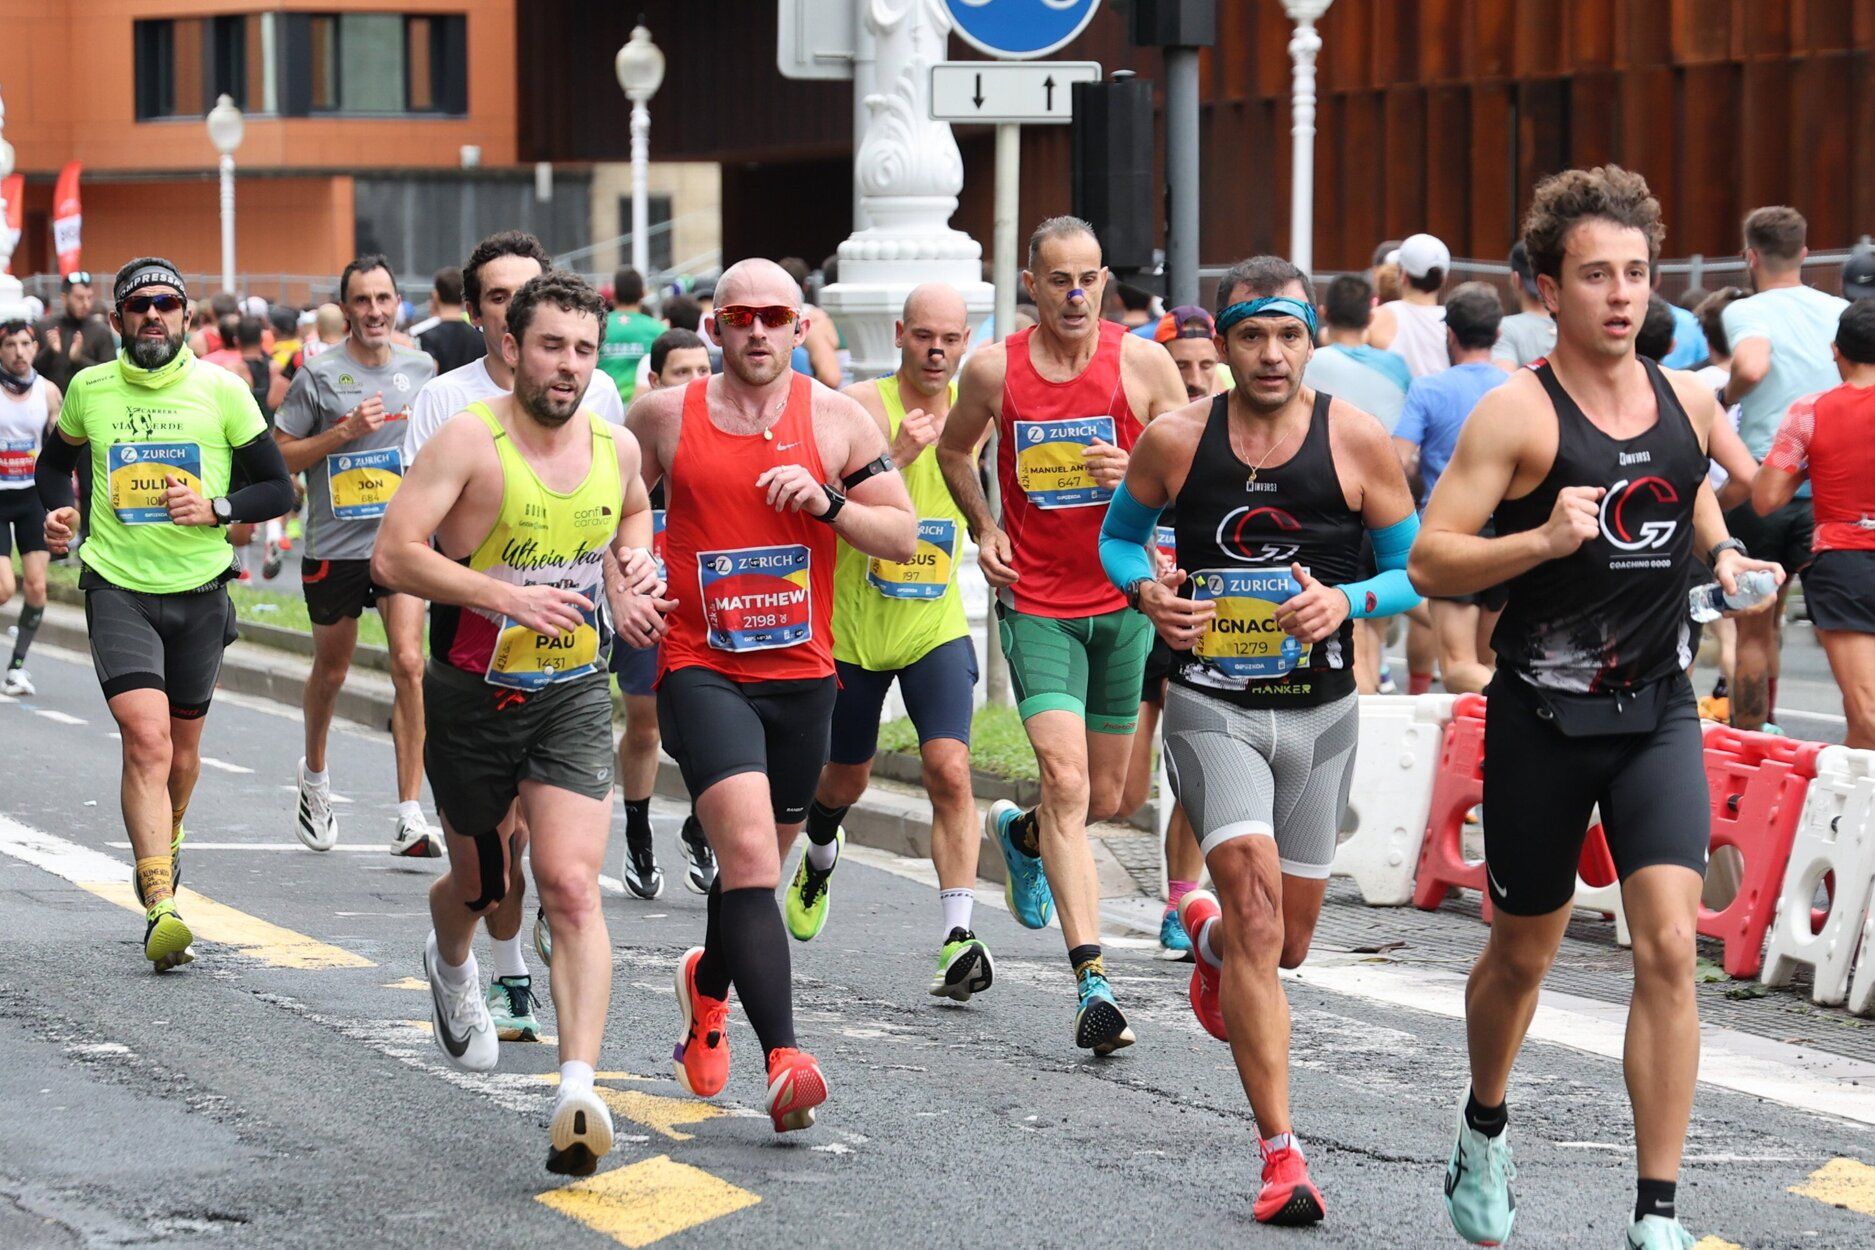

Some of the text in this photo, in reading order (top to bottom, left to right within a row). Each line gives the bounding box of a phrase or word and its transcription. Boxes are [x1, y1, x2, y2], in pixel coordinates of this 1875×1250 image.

[1049, 425, 1097, 439] ZURICH
[142, 449, 186, 459] ZURICH
[355, 454, 390, 466] ZURICH
[1030, 466, 1068, 475] MANUEL
[1070, 464, 1090, 473] ANT
[130, 478, 188, 491] JULIN
[357, 480, 384, 491] JON
[1057, 476, 1081, 488] 647
[146, 497, 161, 506] 10
[361, 493, 380, 503] 684
[574, 506, 602, 520] confi
[917, 526, 944, 536] RICH
[501, 538, 567, 572] Ultreia
[1609, 559, 1672, 570] COACHING GOOD
[1230, 578, 1289, 592] ZURICH
[715, 589, 806, 611] MATTHEW
[743, 614, 776, 628] 2198
[1211, 618, 1284, 634] IGNACI
[535, 633, 575, 649] PAU
[1234, 642, 1268, 655] 1279
[536, 656, 566, 669] 1431
